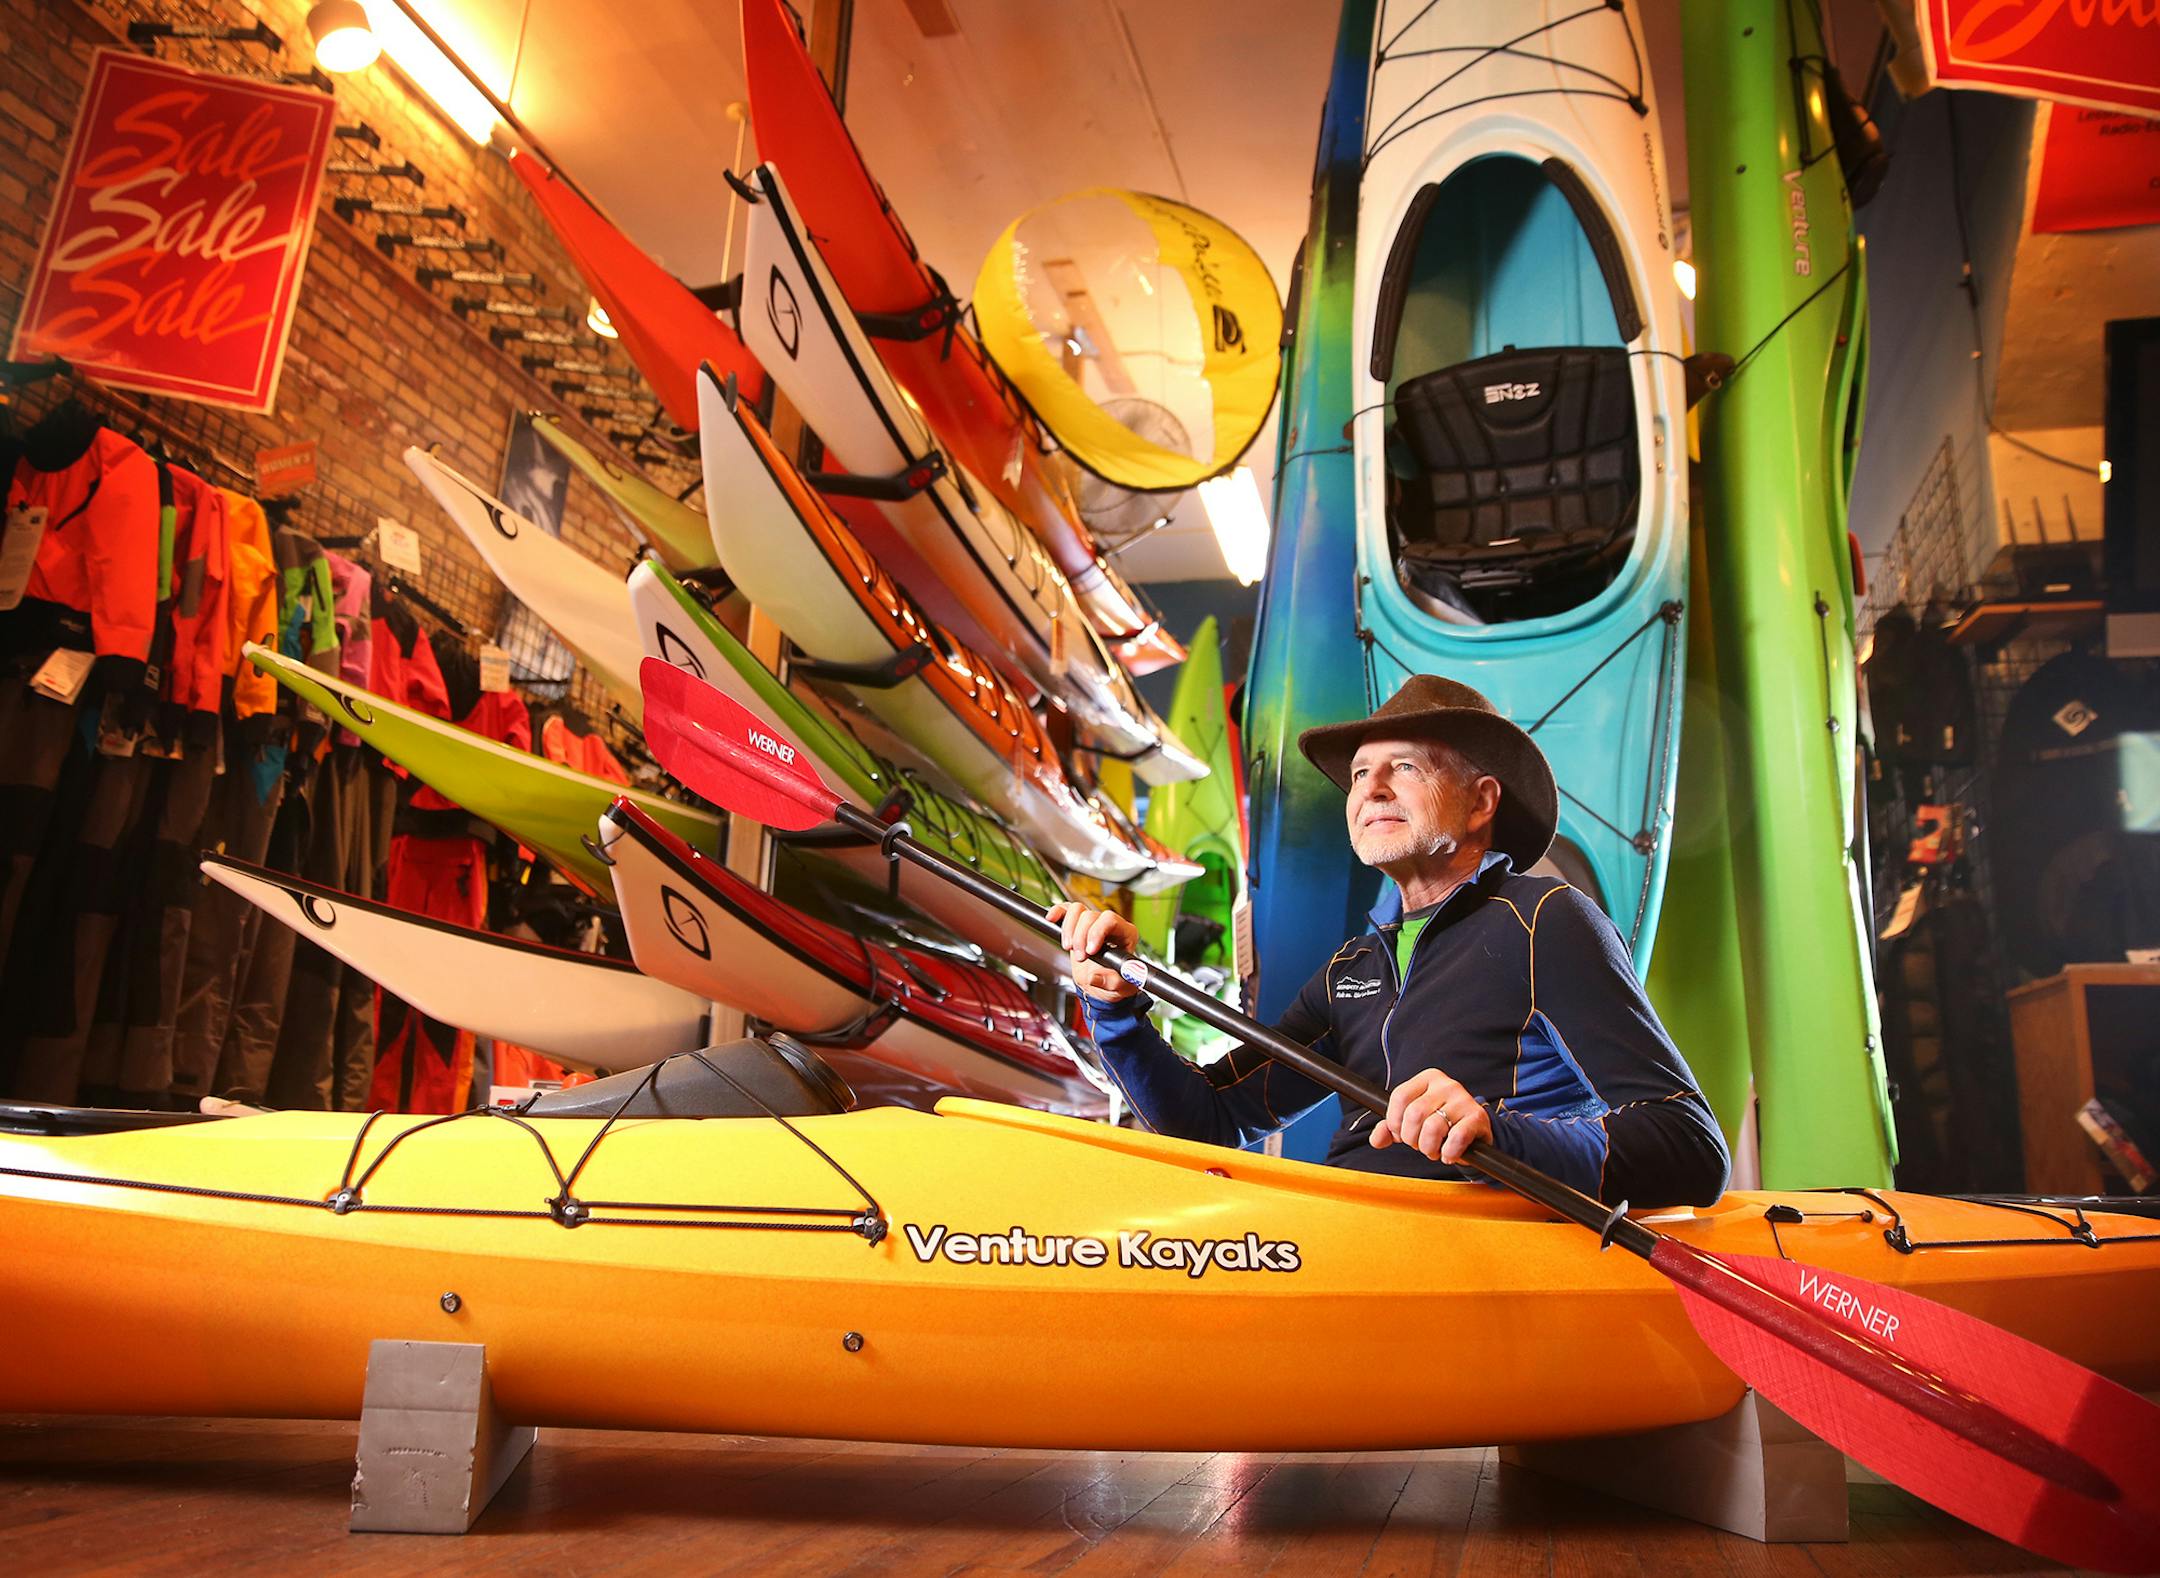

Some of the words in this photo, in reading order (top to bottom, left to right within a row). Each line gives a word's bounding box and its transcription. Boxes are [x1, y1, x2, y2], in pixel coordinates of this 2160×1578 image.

[76, 91, 311, 188] Sale
[50, 167, 296, 271] Sale
[1782, 169, 1811, 276] Venture
[37, 247, 273, 352] Sale
[747, 728, 795, 765] WERNER
[903, 1223, 1108, 1266] Venture
[1118, 1230, 1302, 1279] Kayaks
[1799, 1269, 1900, 1342] WERNER
